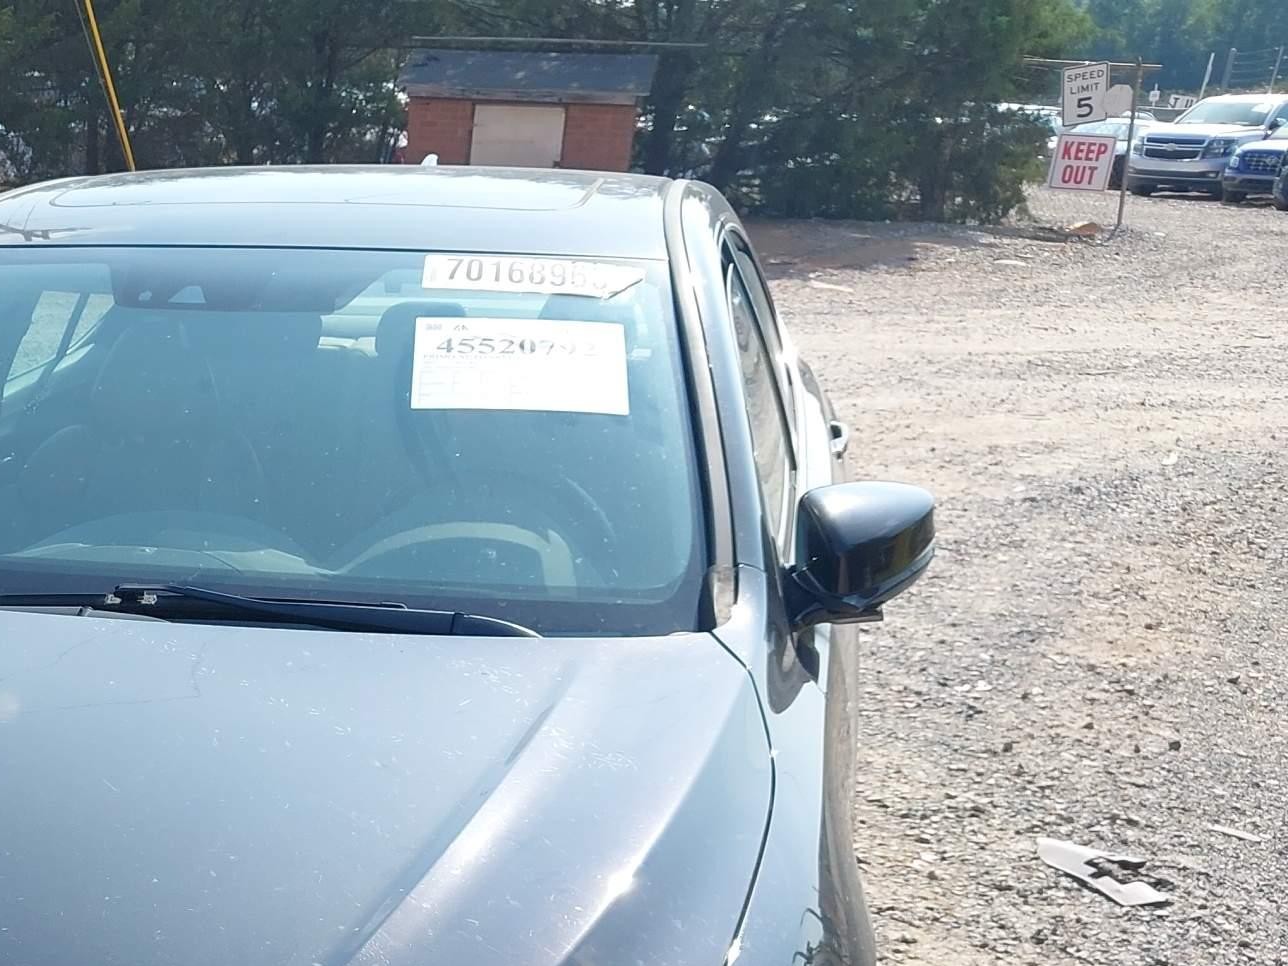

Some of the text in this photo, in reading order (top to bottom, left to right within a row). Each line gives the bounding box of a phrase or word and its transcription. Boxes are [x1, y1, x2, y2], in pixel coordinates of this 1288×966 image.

[1067, 69, 1104, 83] SPEED
[1070, 82, 1100, 95] LIMIT
[1077, 96, 1093, 118] 5
[1061, 141, 1108, 162] KEEP
[1061, 164, 1098, 185] OUT
